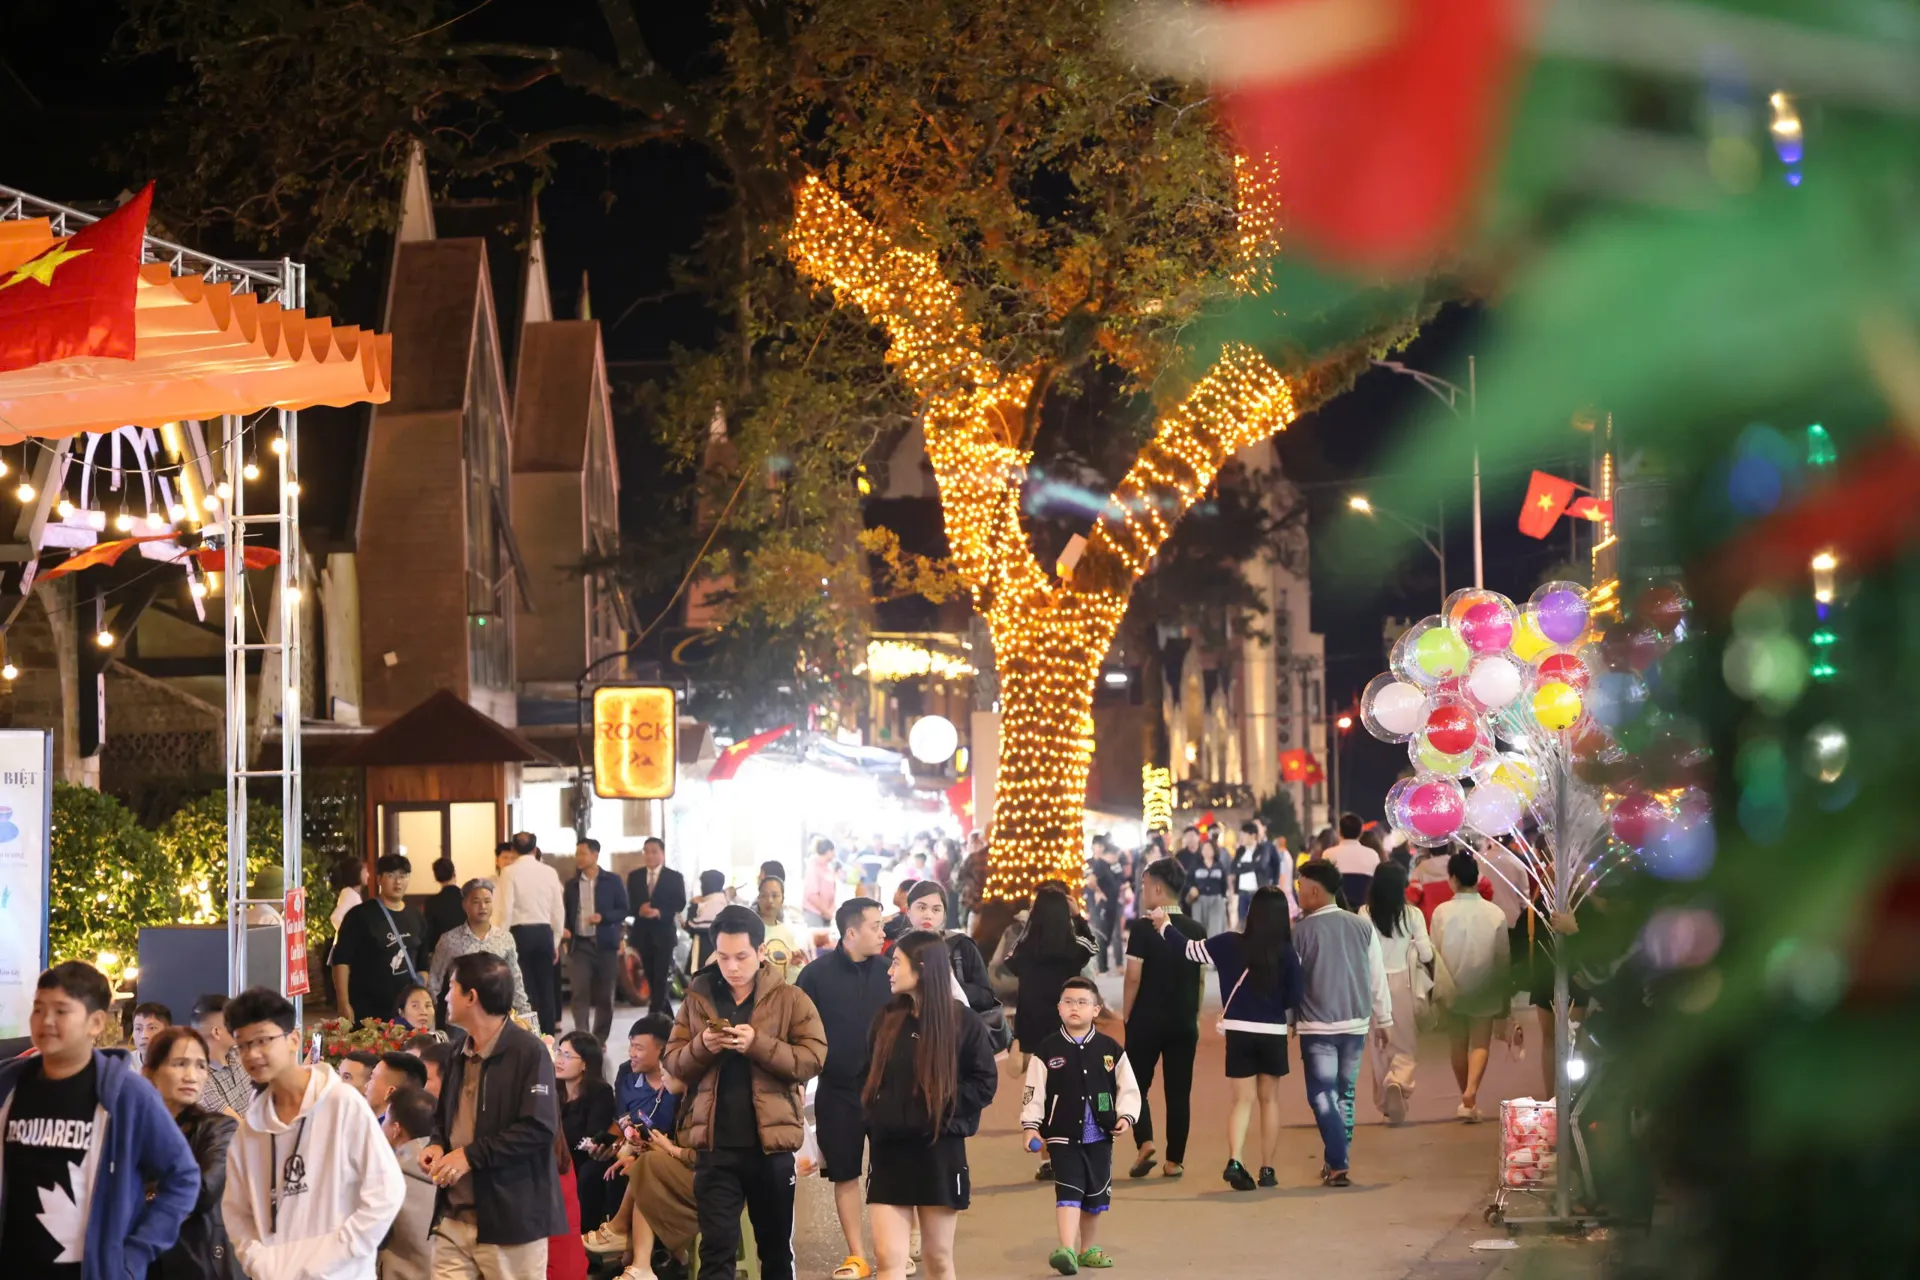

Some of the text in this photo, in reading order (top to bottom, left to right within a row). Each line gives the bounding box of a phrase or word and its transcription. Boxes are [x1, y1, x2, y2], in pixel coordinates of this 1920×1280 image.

[597, 721, 668, 741] ROCK
[3, 768, 38, 789] BIỆT
[6, 1118, 93, 1150] DSQUARED2
